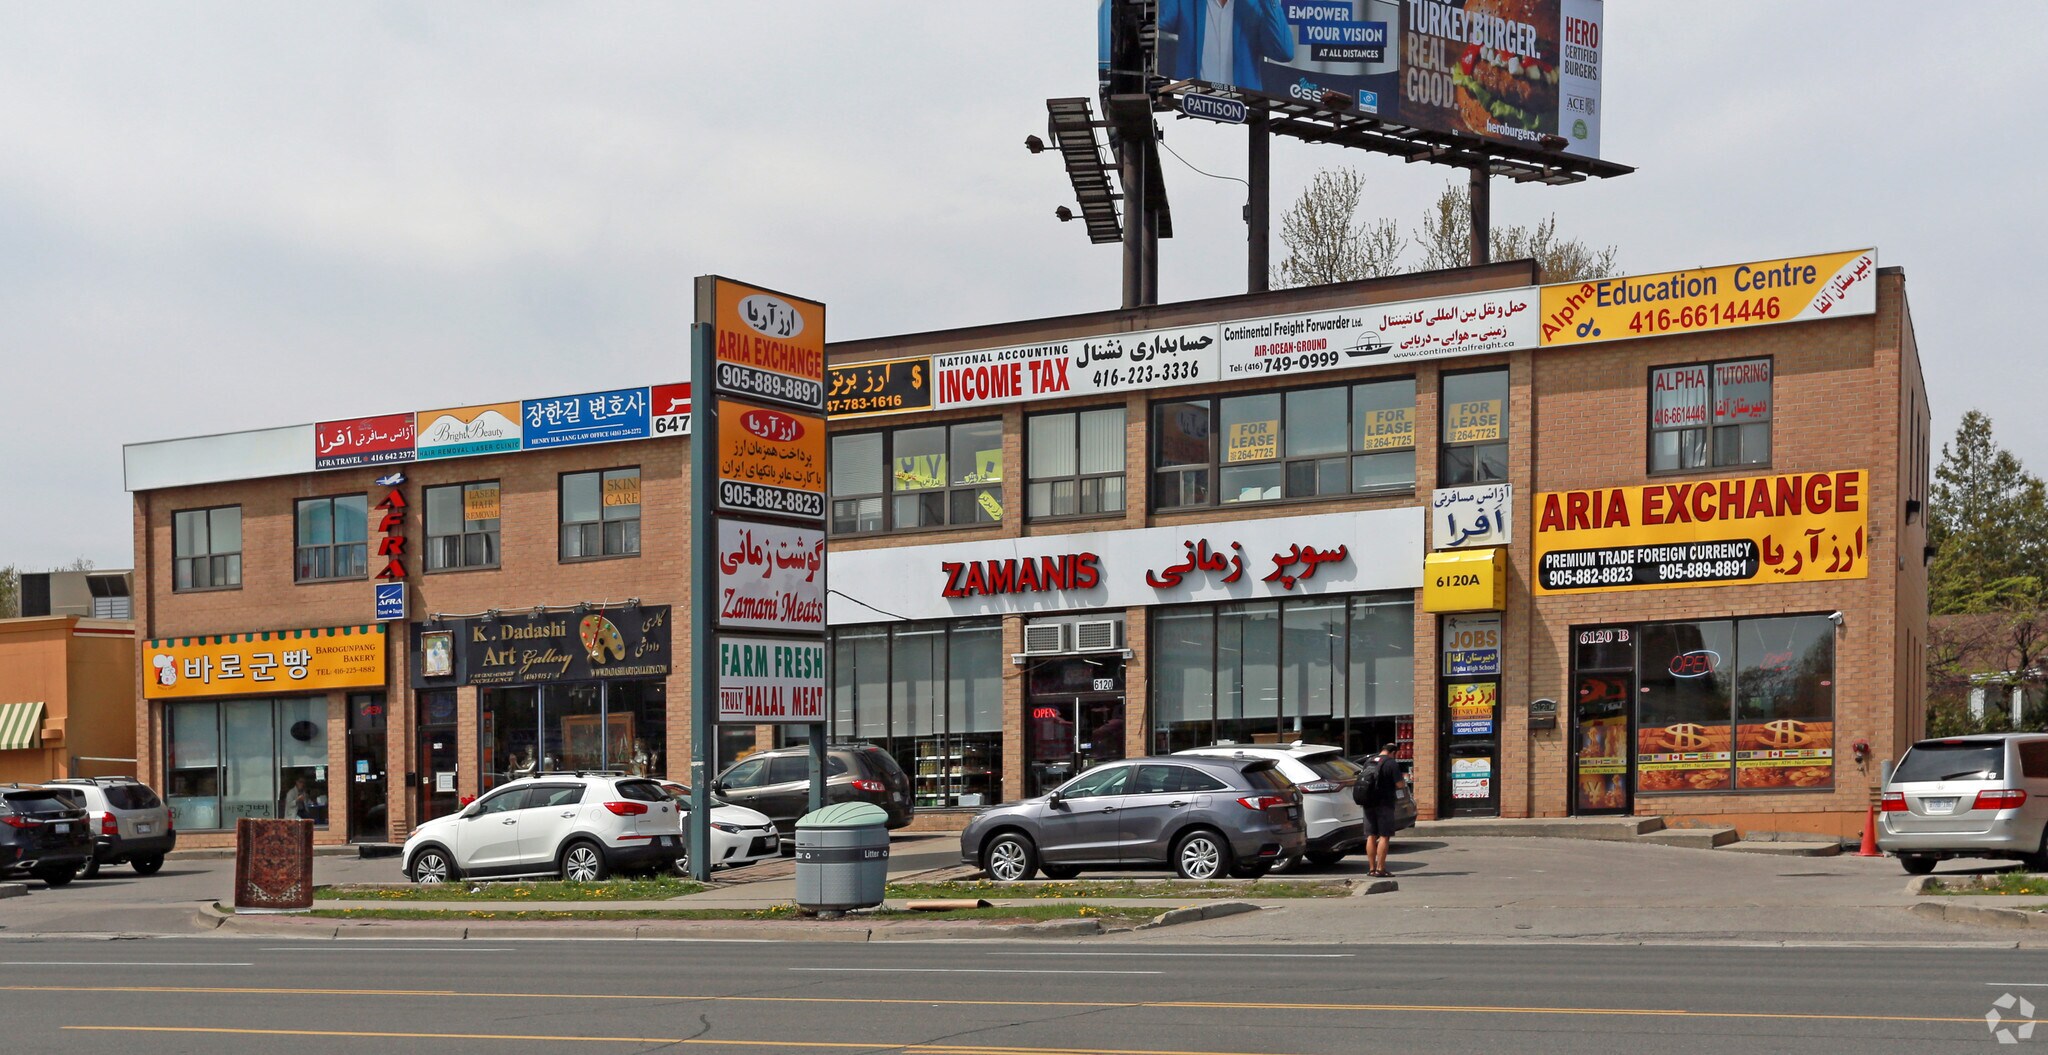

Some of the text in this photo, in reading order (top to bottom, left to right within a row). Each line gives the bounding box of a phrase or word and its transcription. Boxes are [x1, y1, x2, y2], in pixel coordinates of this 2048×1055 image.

[1288, 6, 1350, 22] EMPOWER
[1307, 26, 1383, 42] YOUR VISION
[1407, 0, 1541, 59] TURKEY BURGER.
[1566, 16, 1599, 49] HERO
[1319, 49, 1379, 58] AT ALL DISTANCES
[1407, 32, 1454, 74] REAL.
[1565, 44, 1598, 64] CERTIFIED
[1565, 62, 1597, 81] BURGERS
[1406, 67, 1458, 110] GOOD.
[1188, 97, 1241, 119] PATTISON
[1567, 97, 1585, 111] ACE
[1597, 262, 1817, 308] Education Centre
[1541, 283, 1596, 343] Alpha
[1629, 296, 1780, 334] 416-6614446
[1224, 322, 1272, 342] Continental
[1274, 320, 1304, 338] Freight
[1306, 315, 1350, 333] Forwarder
[718, 329, 822, 378] ARIA EXCHANGE
[939, 345, 1069, 368] NATIONAL ACCOUNTING
[1130, 335, 1214, 362] حسابداری
[1393, 341, 1515, 359] www.continentalfreight.ca
[1230, 351, 1339, 373] Tel: (416) 749-0999
[939, 357, 1070, 404] INCOME TAX
[1093, 360, 1199, 388] 416-223-3336
[1655, 363, 1769, 393] ALPHA TUTORING
[722, 366, 818, 404] 905-889-8891
[527, 398, 580, 428] 장한길
[589, 391, 646, 421] 변호사
[1376, 409, 1404, 423] FOR
[1460, 402, 1489, 416] FOR
[1240, 422, 1267, 436] FOR
[1367, 421, 1412, 437] LEASE
[1450, 414, 1498, 429] LEASE
[433, 420, 503, 443] Bright Beauty
[531, 437, 550, 445] HENRY
[1457, 428, 1497, 441] 264-7725
[439, 447, 469, 455] REMOVAL
[472, 444, 493, 452] LASER
[497, 442, 519, 450] CLINIC
[1231, 434, 1274, 449] LEASE
[1373, 435, 1412, 448] 264-7725
[318, 450, 415, 468] AFRA TRAVEL 416 642 2372
[1238, 447, 1274, 460] 264-7725
[469, 488, 497, 500] LASER
[607, 478, 637, 491] SKIN
[472, 500, 495, 509] HAIR
[605, 493, 638, 506] CARE
[724, 482, 821, 515] 905-882-8823
[1538, 471, 1859, 533] ARIA EXCHANGE
[466, 511, 499, 520] REMOVAL
[374, 488, 409, 579] AFRA
[1546, 542, 1752, 569] PREMIUM TRADE FOREIGN CURRENCY
[941, 552, 1100, 598] ZAMANIS
[1436, 575, 1481, 588] 6120A
[1549, 560, 1747, 586] 905-882-8823 905-889-8891
[378, 598, 403, 606] AFRA
[721, 588, 823, 624] Zamani Meats
[501, 621, 567, 642] Dadashi
[1450, 630, 1498, 649] JOBS
[1580, 629, 1630, 644] 6120 B
[316, 644, 376, 655] BAROGUNPANG
[343, 654, 376, 663] BAKERY
[183, 649, 313, 685] 바로군빵
[482, 646, 573, 674] Art Gallery
[721, 643, 823, 680] FARM FRESH
[1670, 655, 1715, 673] OPEN
[1094, 680, 1113, 690] 6120
[721, 686, 823, 717] TRULY HALAL MEAT
[1034, 708, 1057, 719] OPEN
[1453, 707, 1491, 716] HENRY JANG
[865, 850, 880, 859] Litter
